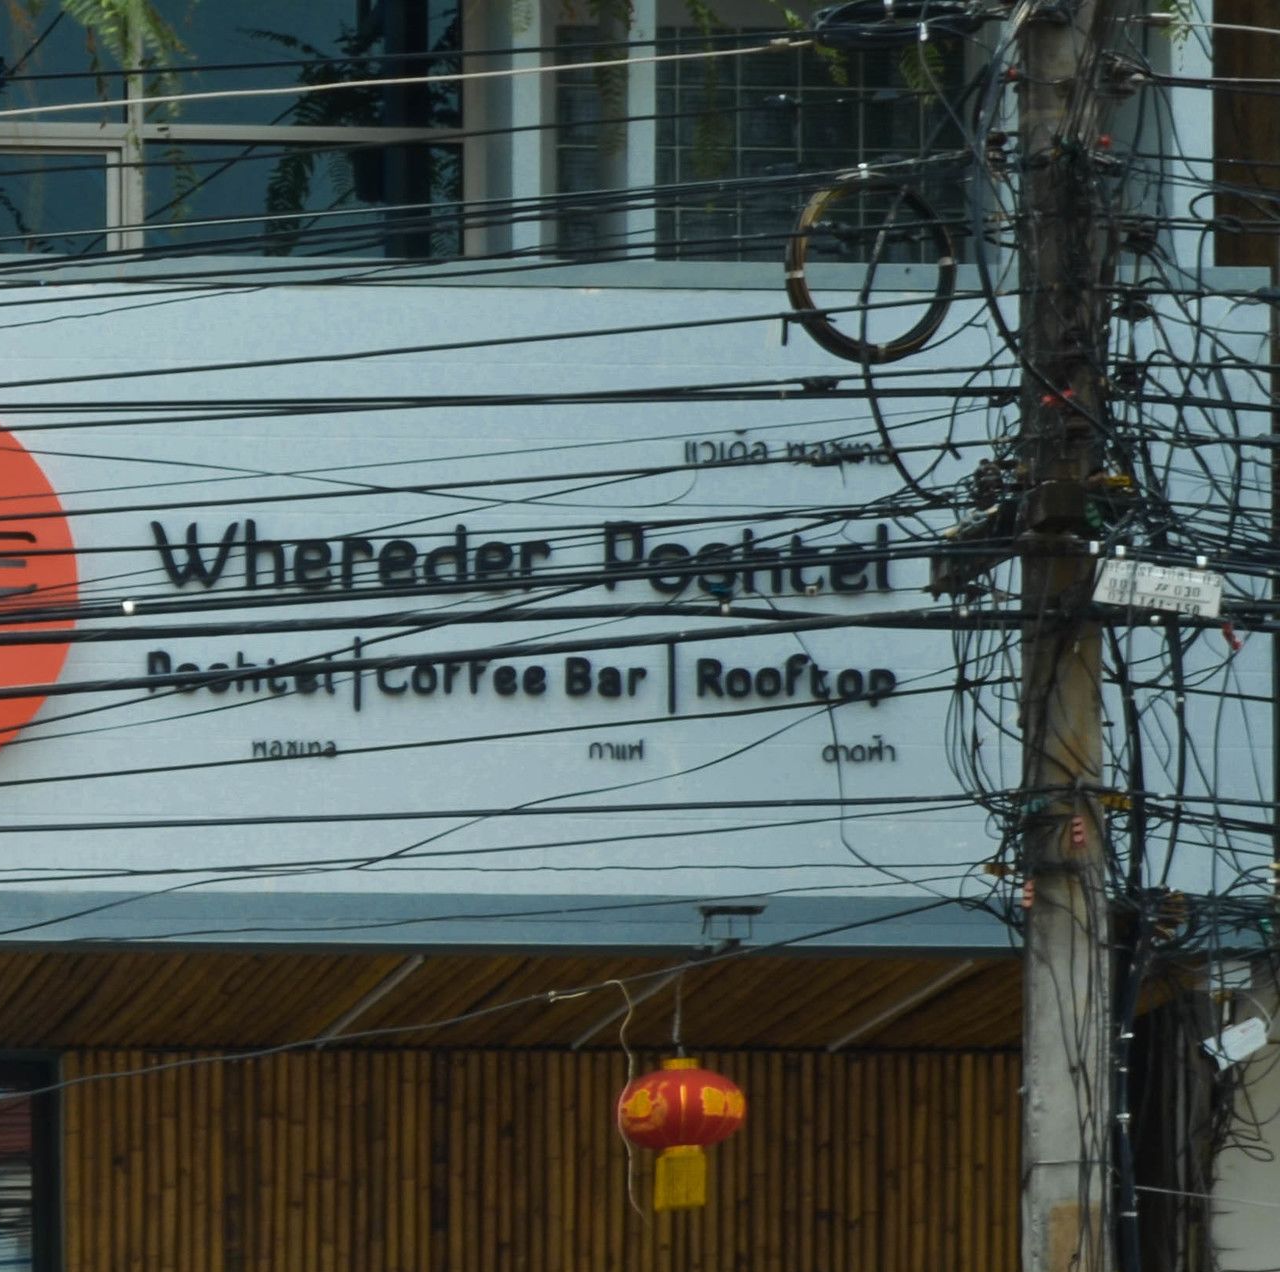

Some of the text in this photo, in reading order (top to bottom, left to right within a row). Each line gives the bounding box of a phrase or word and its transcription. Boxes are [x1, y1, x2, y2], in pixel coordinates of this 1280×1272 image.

[151, 519, 890, 594] Whereder Poshtel
[147, 650, 337, 697] Poshtel
[376, 651, 648, 698] Coffee Bar
[697, 652, 897, 706] Rooftop
[589, 738, 644, 761] กาแฟ
